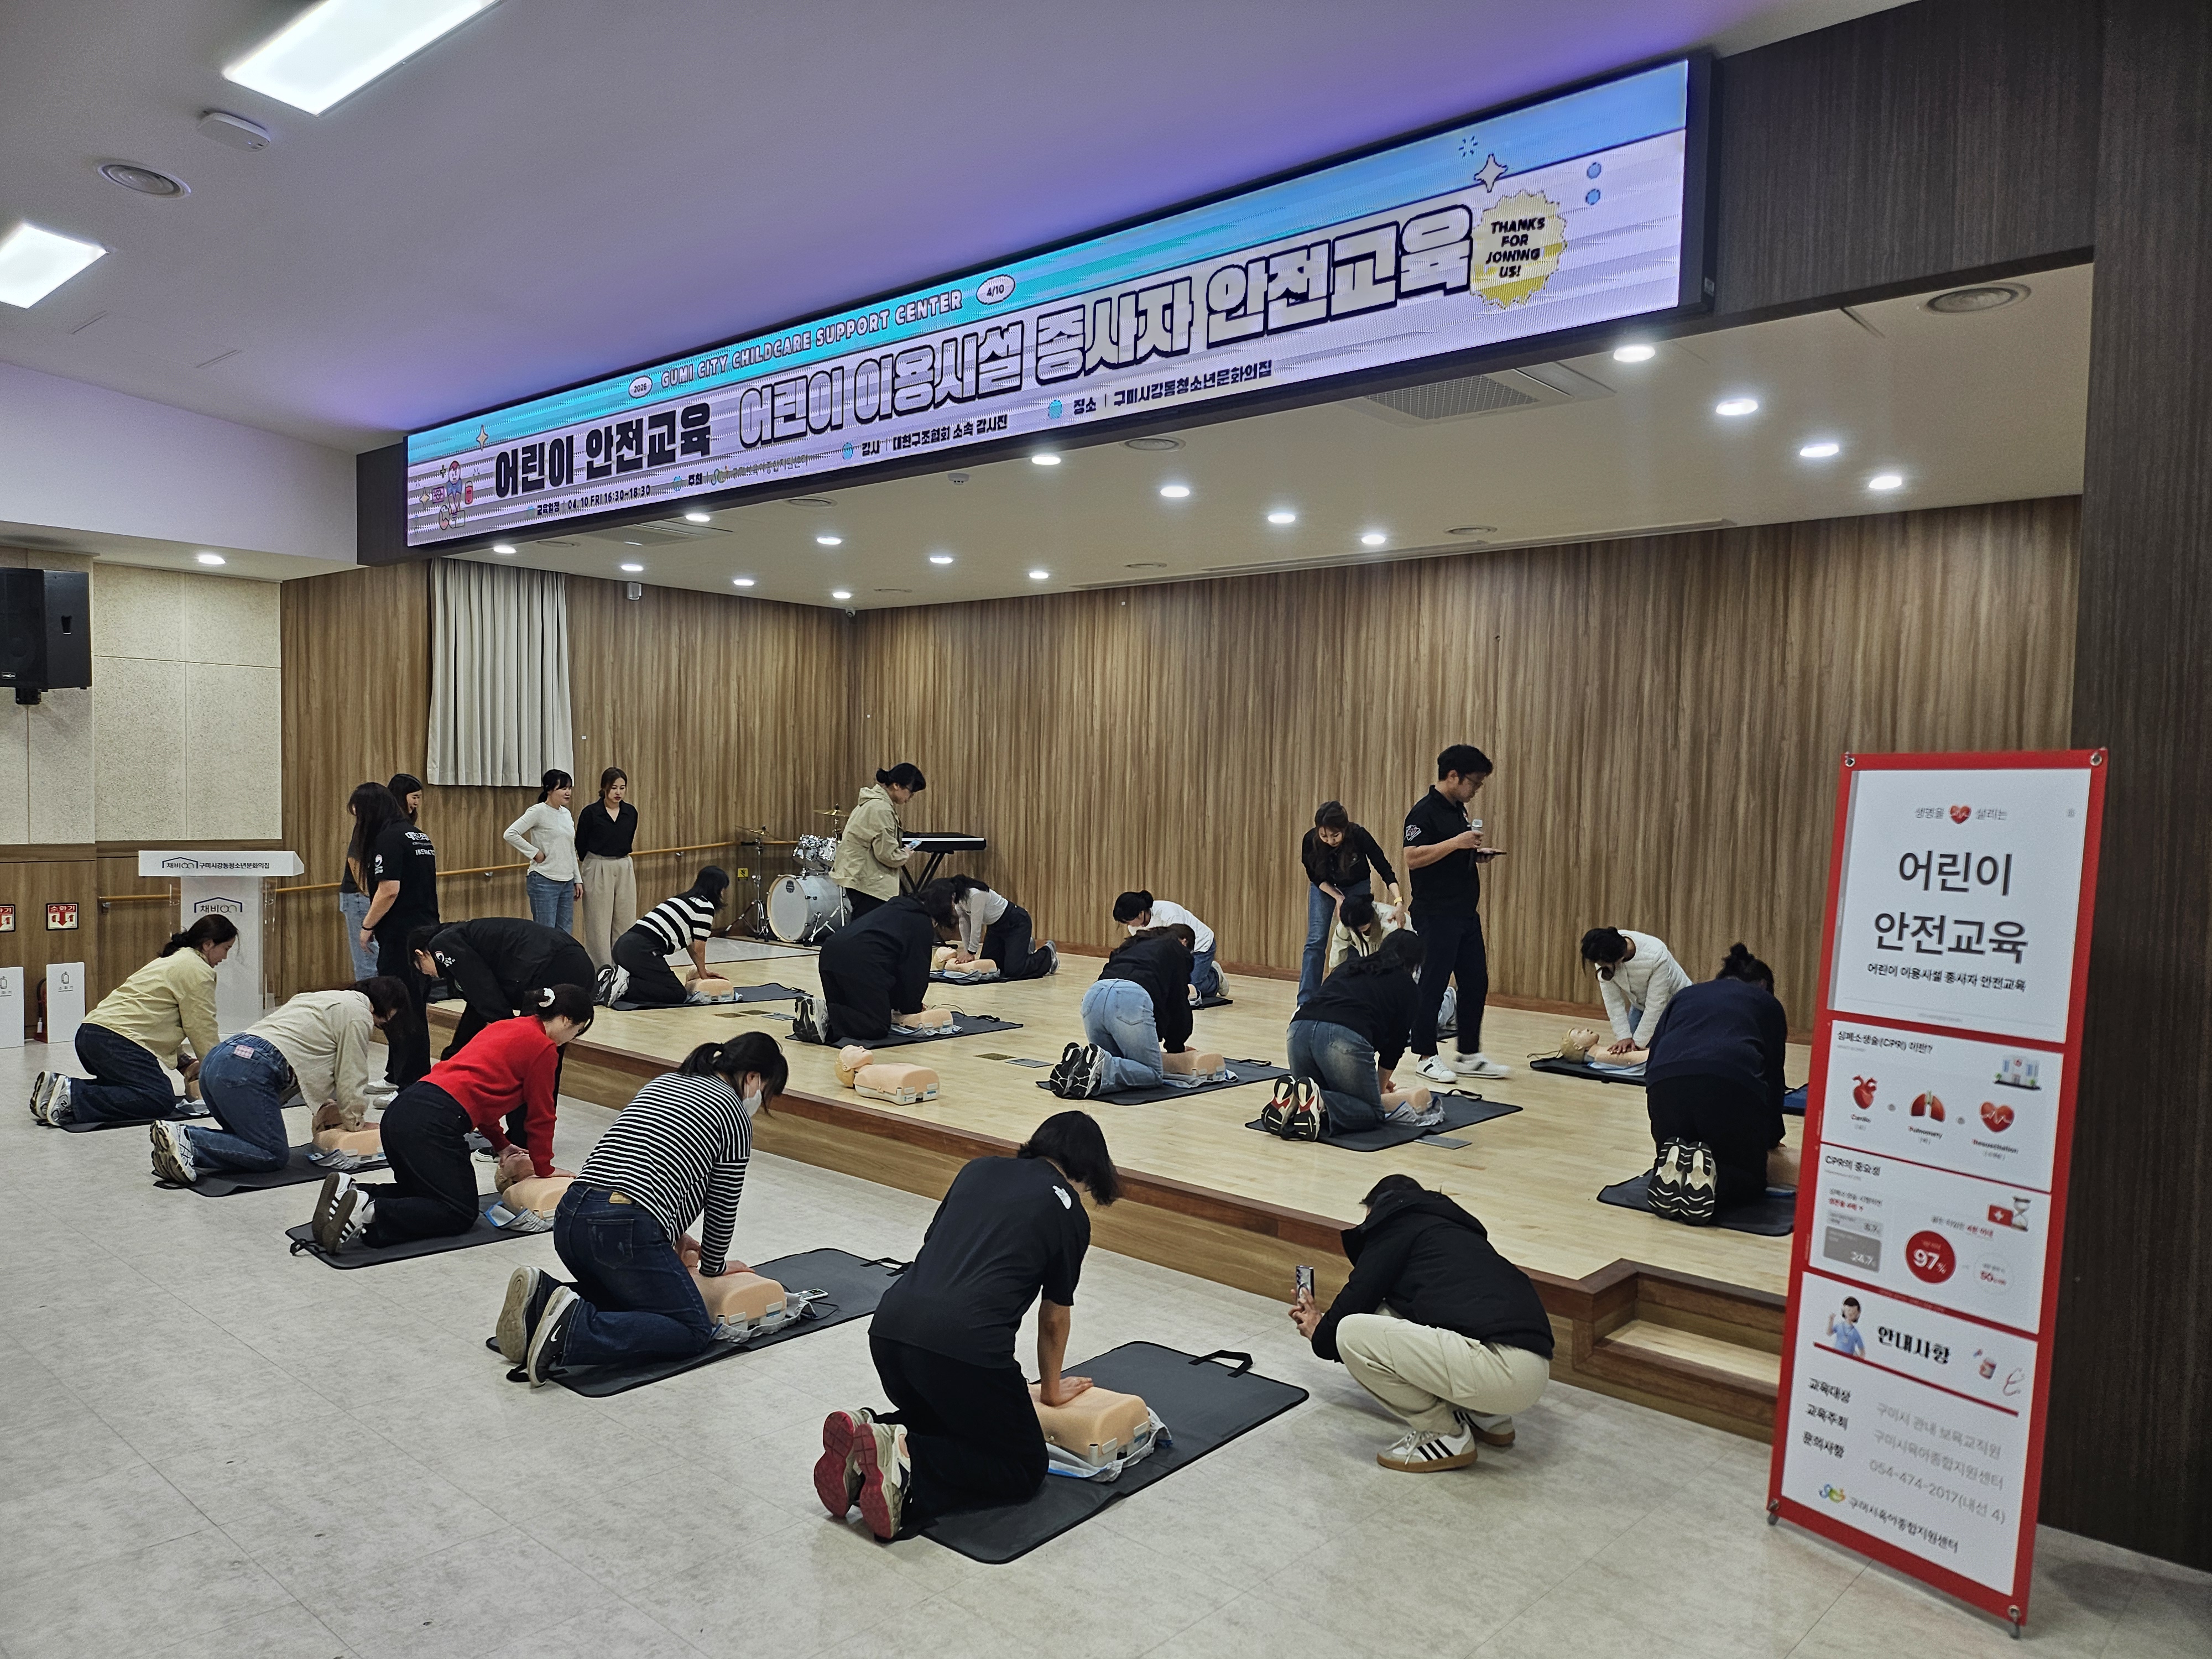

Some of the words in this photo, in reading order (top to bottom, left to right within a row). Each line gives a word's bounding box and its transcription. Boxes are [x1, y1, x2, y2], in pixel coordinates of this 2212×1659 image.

[1490, 217, 1546, 234] THANKS
[1501, 233, 1529, 248] FOR
[1485, 247, 1541, 265] JOINING
[1499, 264, 1522, 278] US!
[987, 283, 1005, 298] 4/10
[495, 434, 574, 498] 어린이
[586, 402, 711, 481] 안전교육
[739, 366, 845, 450] 어린이
[854, 321, 1024, 426] 이용시설
[1035, 276, 1194, 386] 종사자
[1206, 204, 1474, 350] 안전교육
[661, 367, 696, 388] GUMI
[697, 356, 729, 377] CITY
[732, 331, 812, 368] CHILDCARE
[815, 310, 890, 348] SUPPORT
[894, 289, 963, 325] CENTER
[1073, 397, 1097, 415] 장소
[1113, 359, 1272, 406] 구미시강동청소년문화의집
[893, 425, 951, 451] 대한구조협회
[952, 421, 974, 439] 소속
[975, 414, 1008, 434] 강사진
[581, 497, 589, 507] 10
[590, 493, 603, 505] FRI
[1899, 849, 2013, 897] 어린이
[1874, 911, 2028, 964] 안전교육
[1867, 963, 1898, 978] 어린이
[1900, 967, 1943, 983] 이용시설
[1944, 971, 1978, 987] 종사자
[1980, 975, 2026, 993] 안전교육
[1877, 1326, 1950, 1365] 안내사항
[1808, 1376, 1851, 1404] 교육대상
[1876, 1401, 1911, 1427] 구미시
[1803, 1430, 1845, 1459] 문의사항
